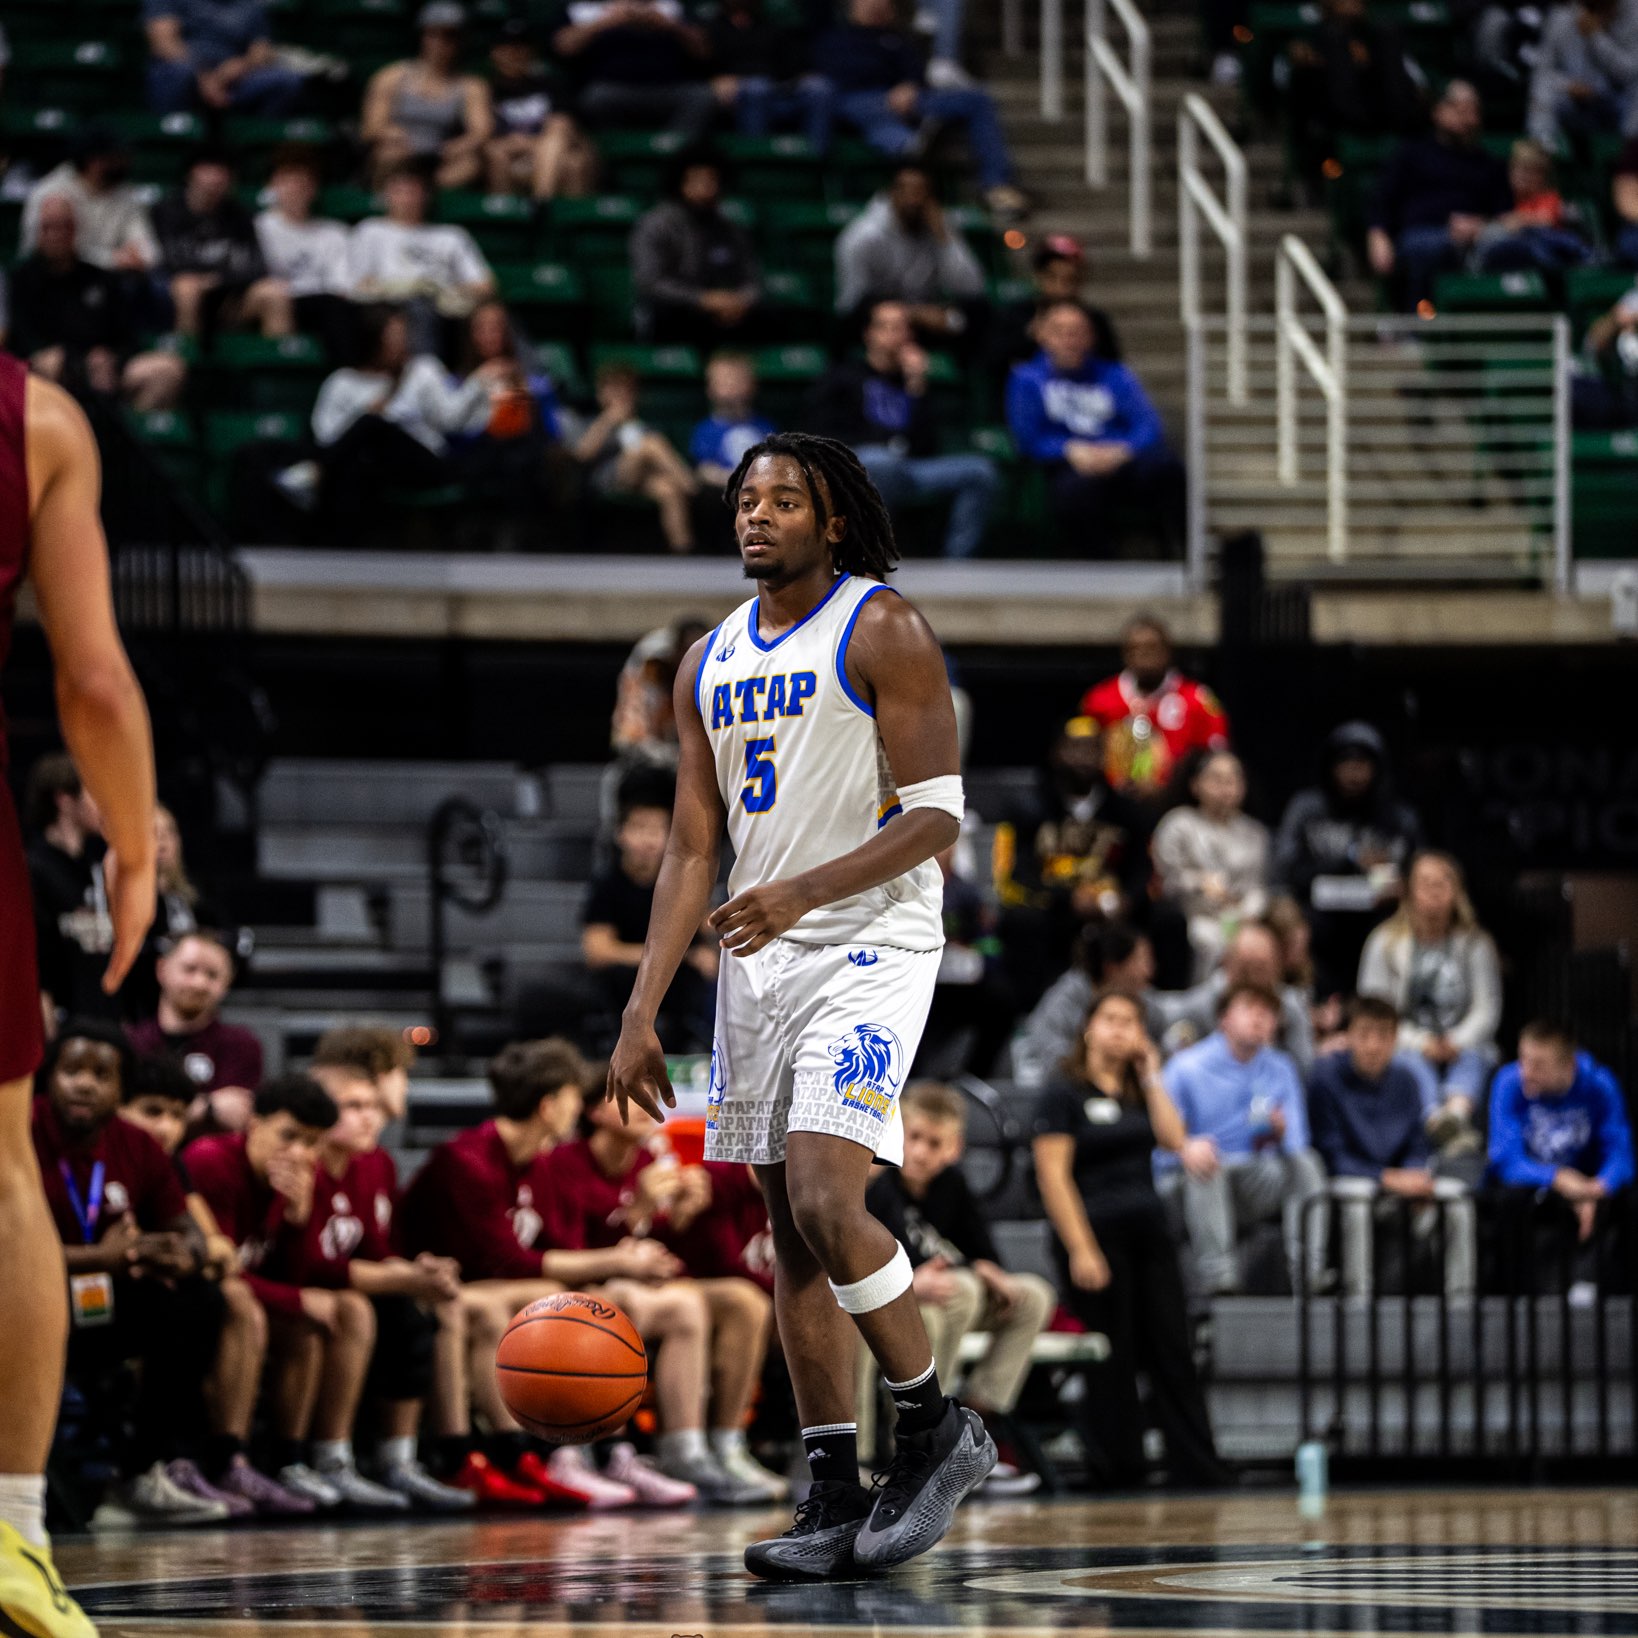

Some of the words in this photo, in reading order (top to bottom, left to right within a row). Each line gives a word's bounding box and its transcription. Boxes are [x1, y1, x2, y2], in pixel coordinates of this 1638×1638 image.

[711, 669, 818, 732] ATAP
[740, 734, 777, 816] 5
[844, 1083, 891, 1115] LIONS
[866, 1080, 885, 1092] ATAP
[841, 1098, 884, 1123] BASKETBALL
